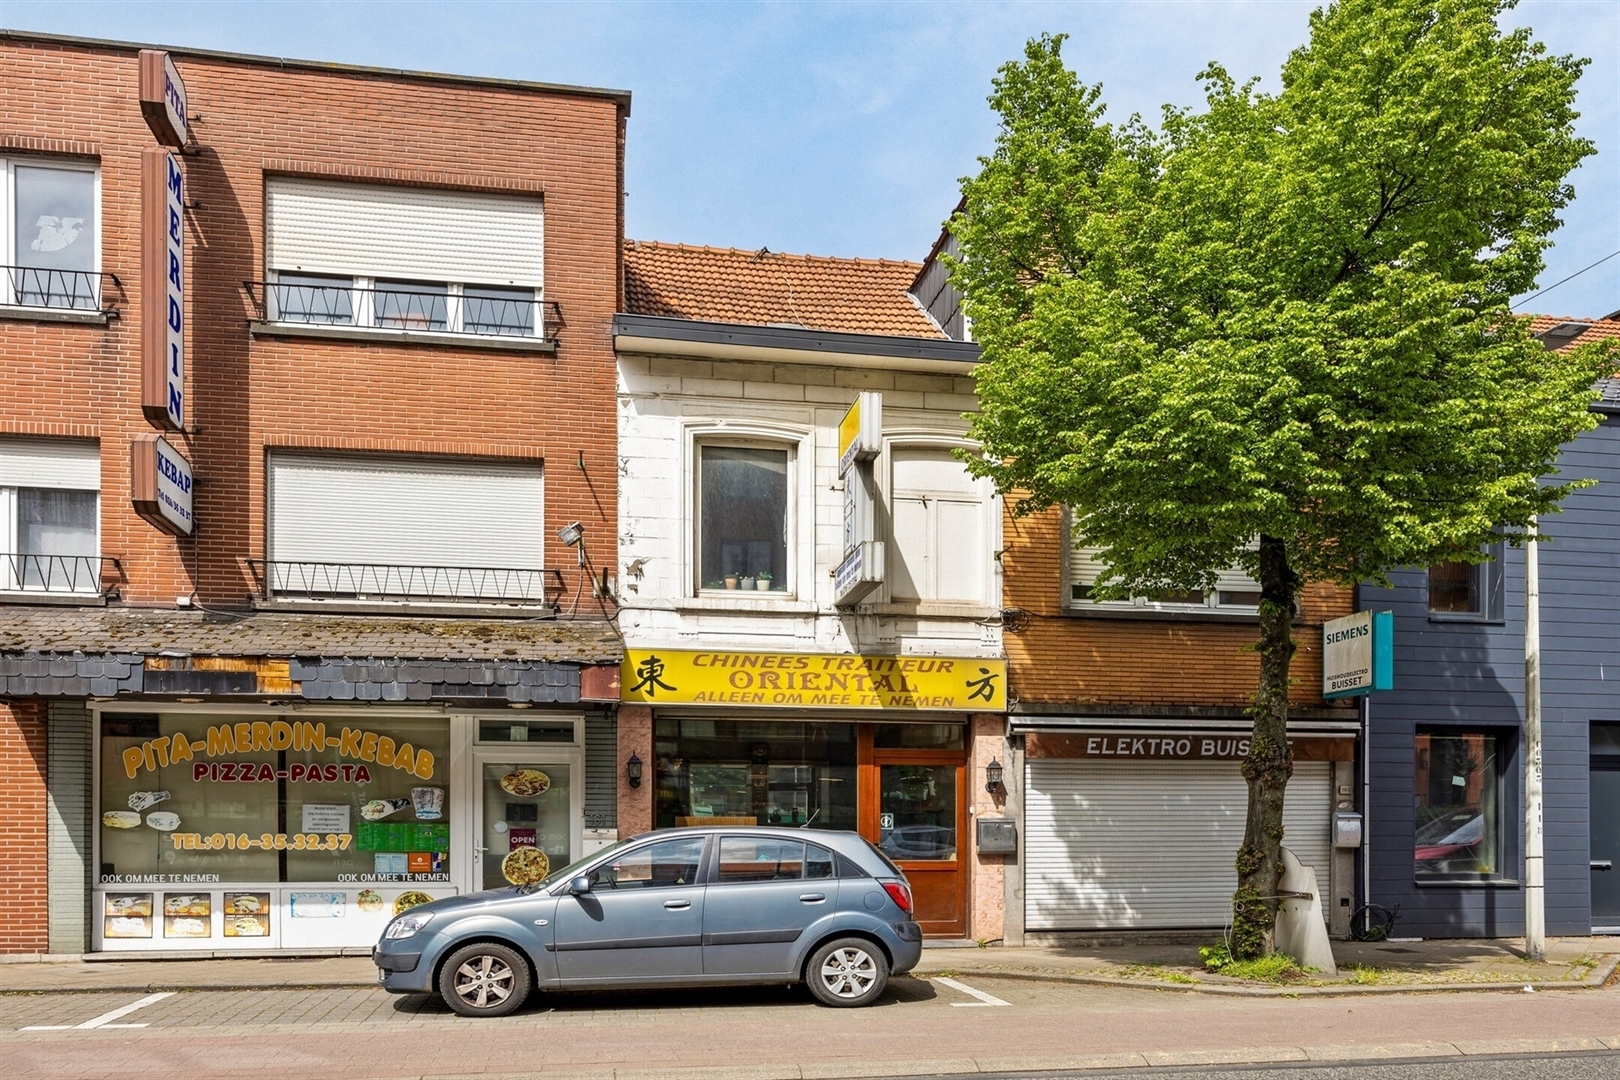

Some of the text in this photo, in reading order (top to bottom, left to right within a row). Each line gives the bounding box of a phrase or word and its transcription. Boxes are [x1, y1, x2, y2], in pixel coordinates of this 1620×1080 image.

[164, 70, 187, 129] PITA
[168, 157, 182, 423] MERDIN
[157, 451, 191, 494] KEBAP
[1326, 624, 1369, 645] SIEMENS
[692, 653, 955, 674] CHINEES TRAITEUR
[729, 670, 919, 694] ORIENTAL
[965, 667, 1000, 702] 方
[1326, 668, 1369, 682] HUISHOUDELECTRO
[1331, 676, 1363, 690] BUISSET
[693, 690, 955, 708] ALLEEN OM MEE TE NEMEN
[121, 720, 436, 781] PITA-MERDIN-KEBAB
[1086, 737, 1191, 756] ELEKTRO
[191, 762, 372, 784] PIZZA-PASTA
[170, 832, 353, 851] TEL:016-35.32.37
[511, 836, 535, 844] OPEN
[101, 873, 220, 883] OOK OM MEE TE NEMEN
[337, 873, 449, 882] OOK OM MEE TE NEMEN
